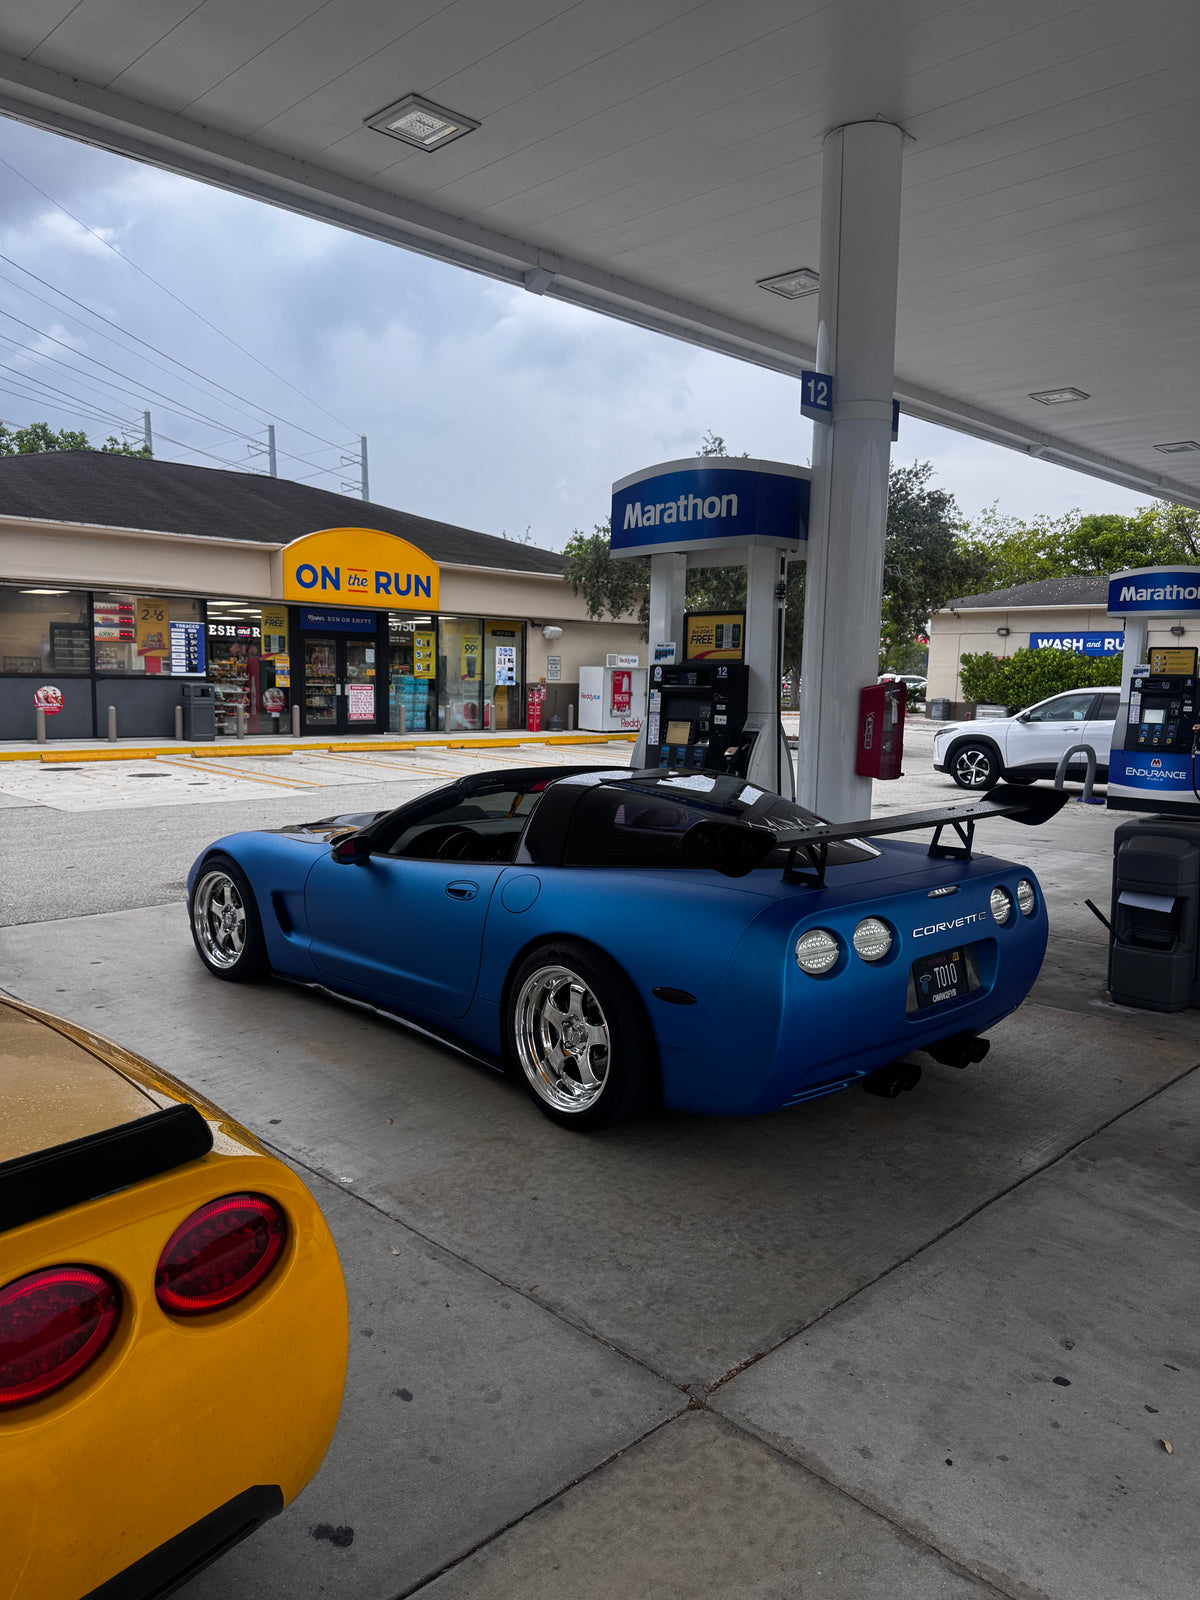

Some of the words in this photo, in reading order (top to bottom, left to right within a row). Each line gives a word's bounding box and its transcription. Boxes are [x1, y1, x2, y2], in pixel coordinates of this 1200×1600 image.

[807, 379, 828, 406] 12
[623, 493, 738, 530] Marathon
[295, 563, 341, 591] ON
[347, 574, 368, 587] the
[375, 570, 431, 598] RUN
[1119, 585, 1200, 602] Maratho
[208, 624, 236, 636] ESH
[691, 635, 713, 644] FREE
[1037, 638, 1084, 651] WASH
[1086, 640, 1101, 648] and
[717, 666, 728, 676] 12
[1125, 767, 1187, 780] ENDURANCE
